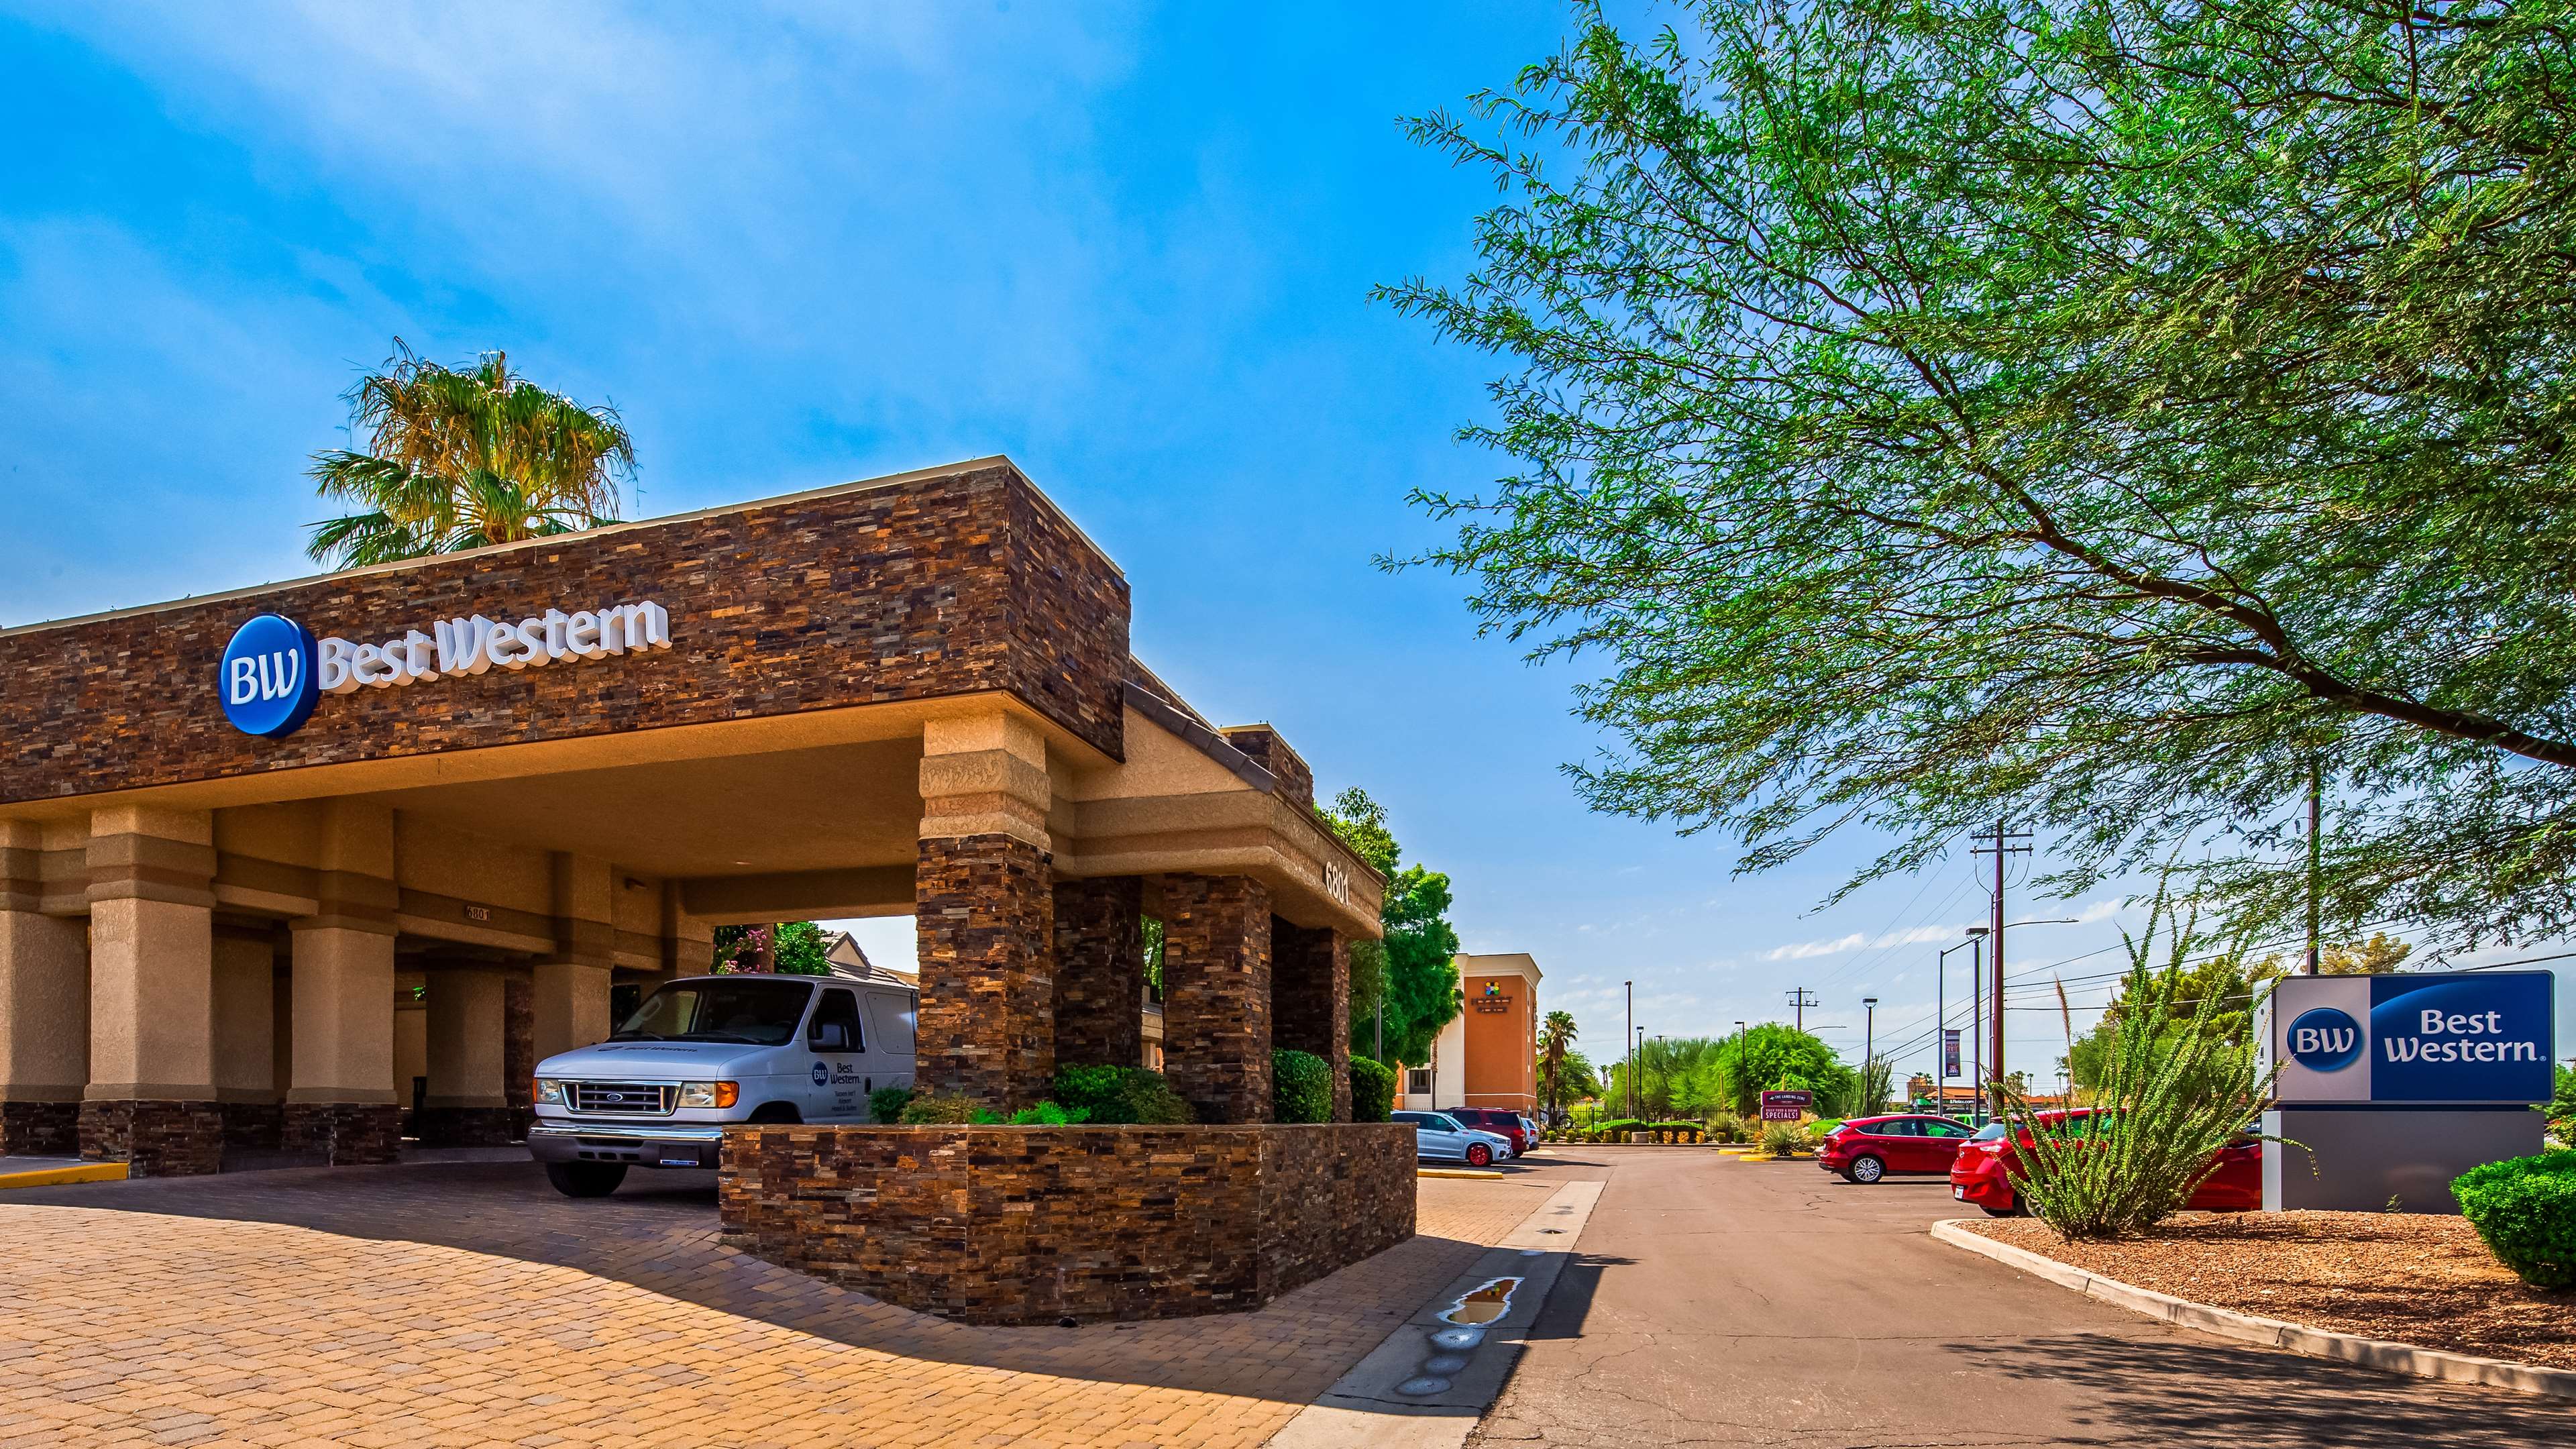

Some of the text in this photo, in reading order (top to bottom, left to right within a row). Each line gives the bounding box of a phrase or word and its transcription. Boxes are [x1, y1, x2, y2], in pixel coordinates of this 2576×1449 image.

[318, 600, 671, 694] Best Western
[231, 649, 299, 705] BW
[1326, 861, 1348, 906] 6801
[467, 906, 489, 921] 6801
[2421, 1009, 2502, 1034] Best
[2297, 1028, 2355, 1053] BW
[814, 1069, 827, 1080] BW
[837, 1063, 853, 1073] Best
